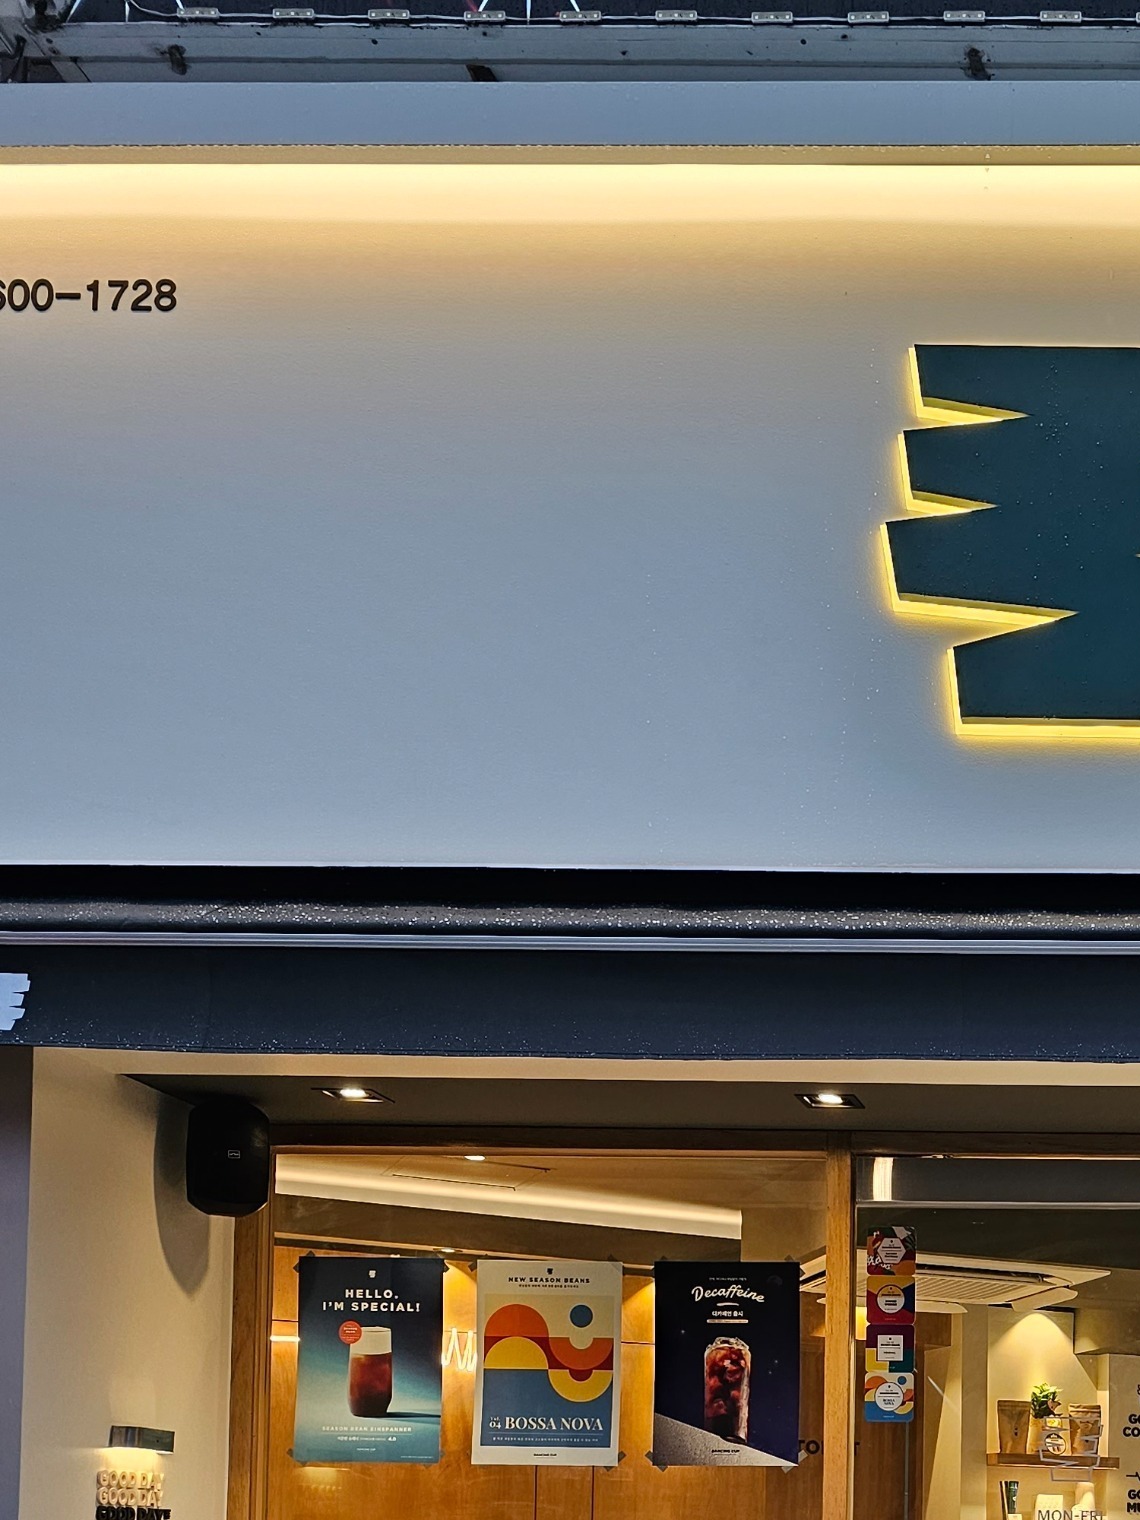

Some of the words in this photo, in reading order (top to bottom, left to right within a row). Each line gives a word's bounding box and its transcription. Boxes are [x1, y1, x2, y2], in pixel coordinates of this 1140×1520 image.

[691, 1284, 765, 1303] Decaffeine
[351, 1302, 420, 1312] SPECIAL!
[505, 1416, 557, 1430] BOSSA
[560, 1417, 603, 1431] NOVA
[97, 1470, 137, 1489] GOOD
[139, 1472, 164, 1491] DAY
[97, 1487, 137, 1506] GOOD
[138, 1489, 163, 1508] DAY
